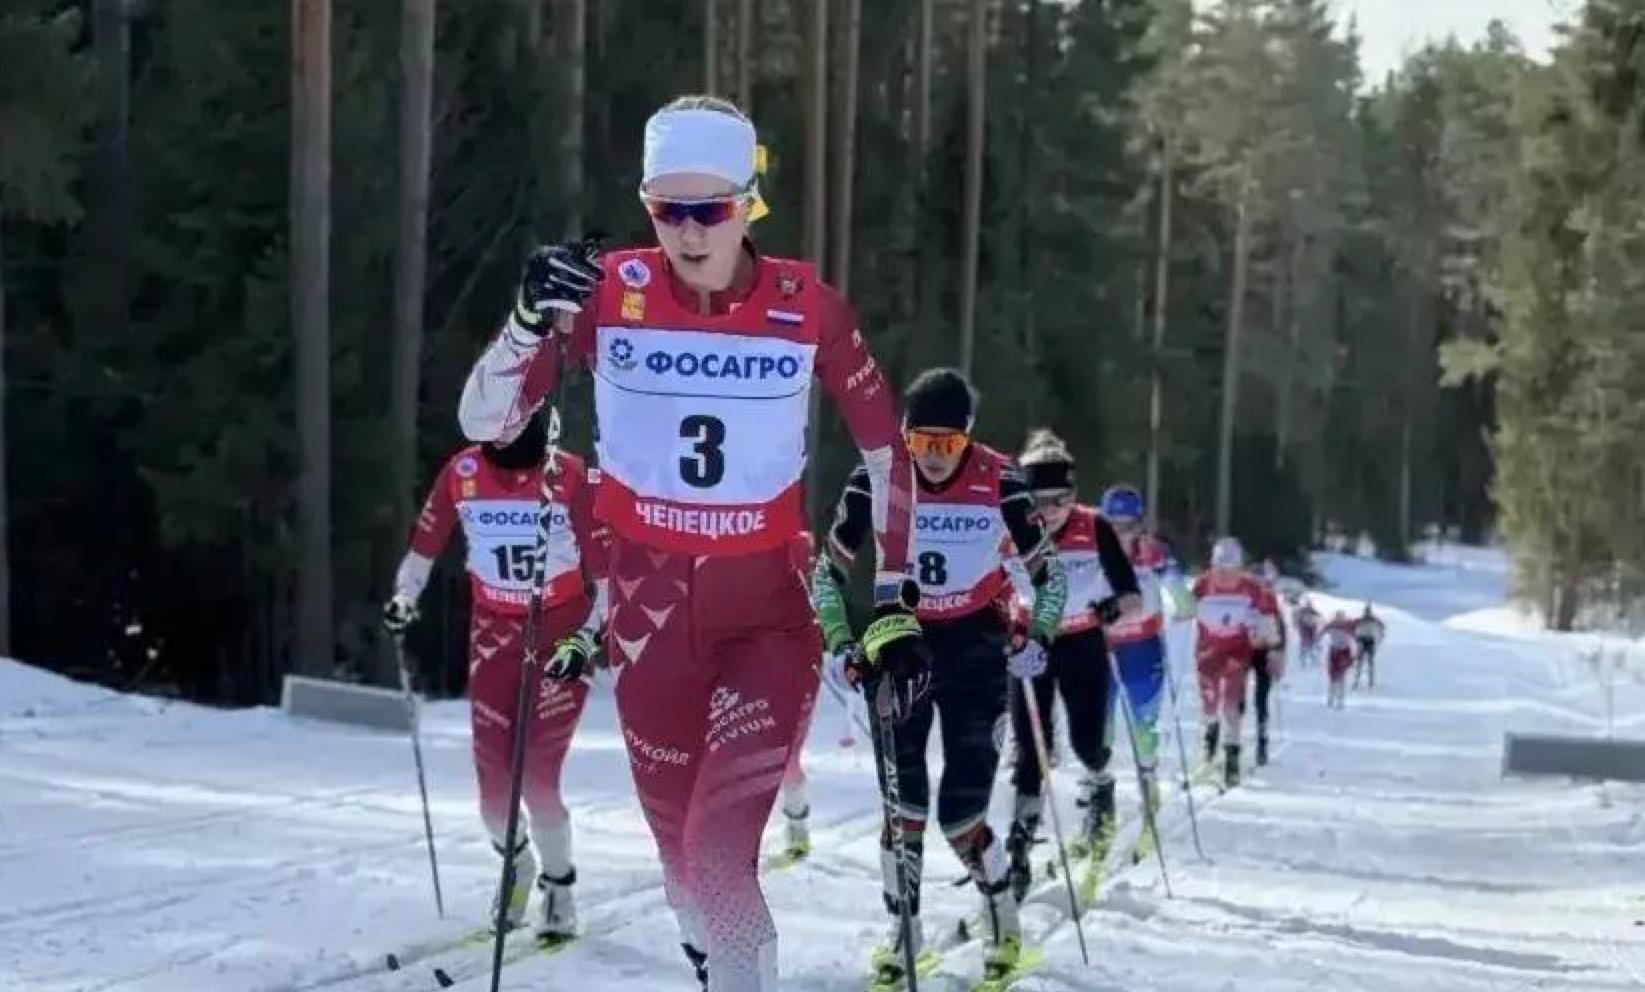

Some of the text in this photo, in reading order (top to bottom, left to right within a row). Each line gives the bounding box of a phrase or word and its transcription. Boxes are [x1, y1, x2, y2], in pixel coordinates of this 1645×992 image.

[645, 350, 799, 379] ФОСАГРО
[679, 414, 725, 488] 3
[480, 511, 566, 526] ФОСАГО
[635, 501, 767, 540] ЧЕПЕЦКОЕ
[916, 515, 990, 531] ОСАГРО
[489, 544, 536, 581] 15
[918, 551, 947, 585] 8
